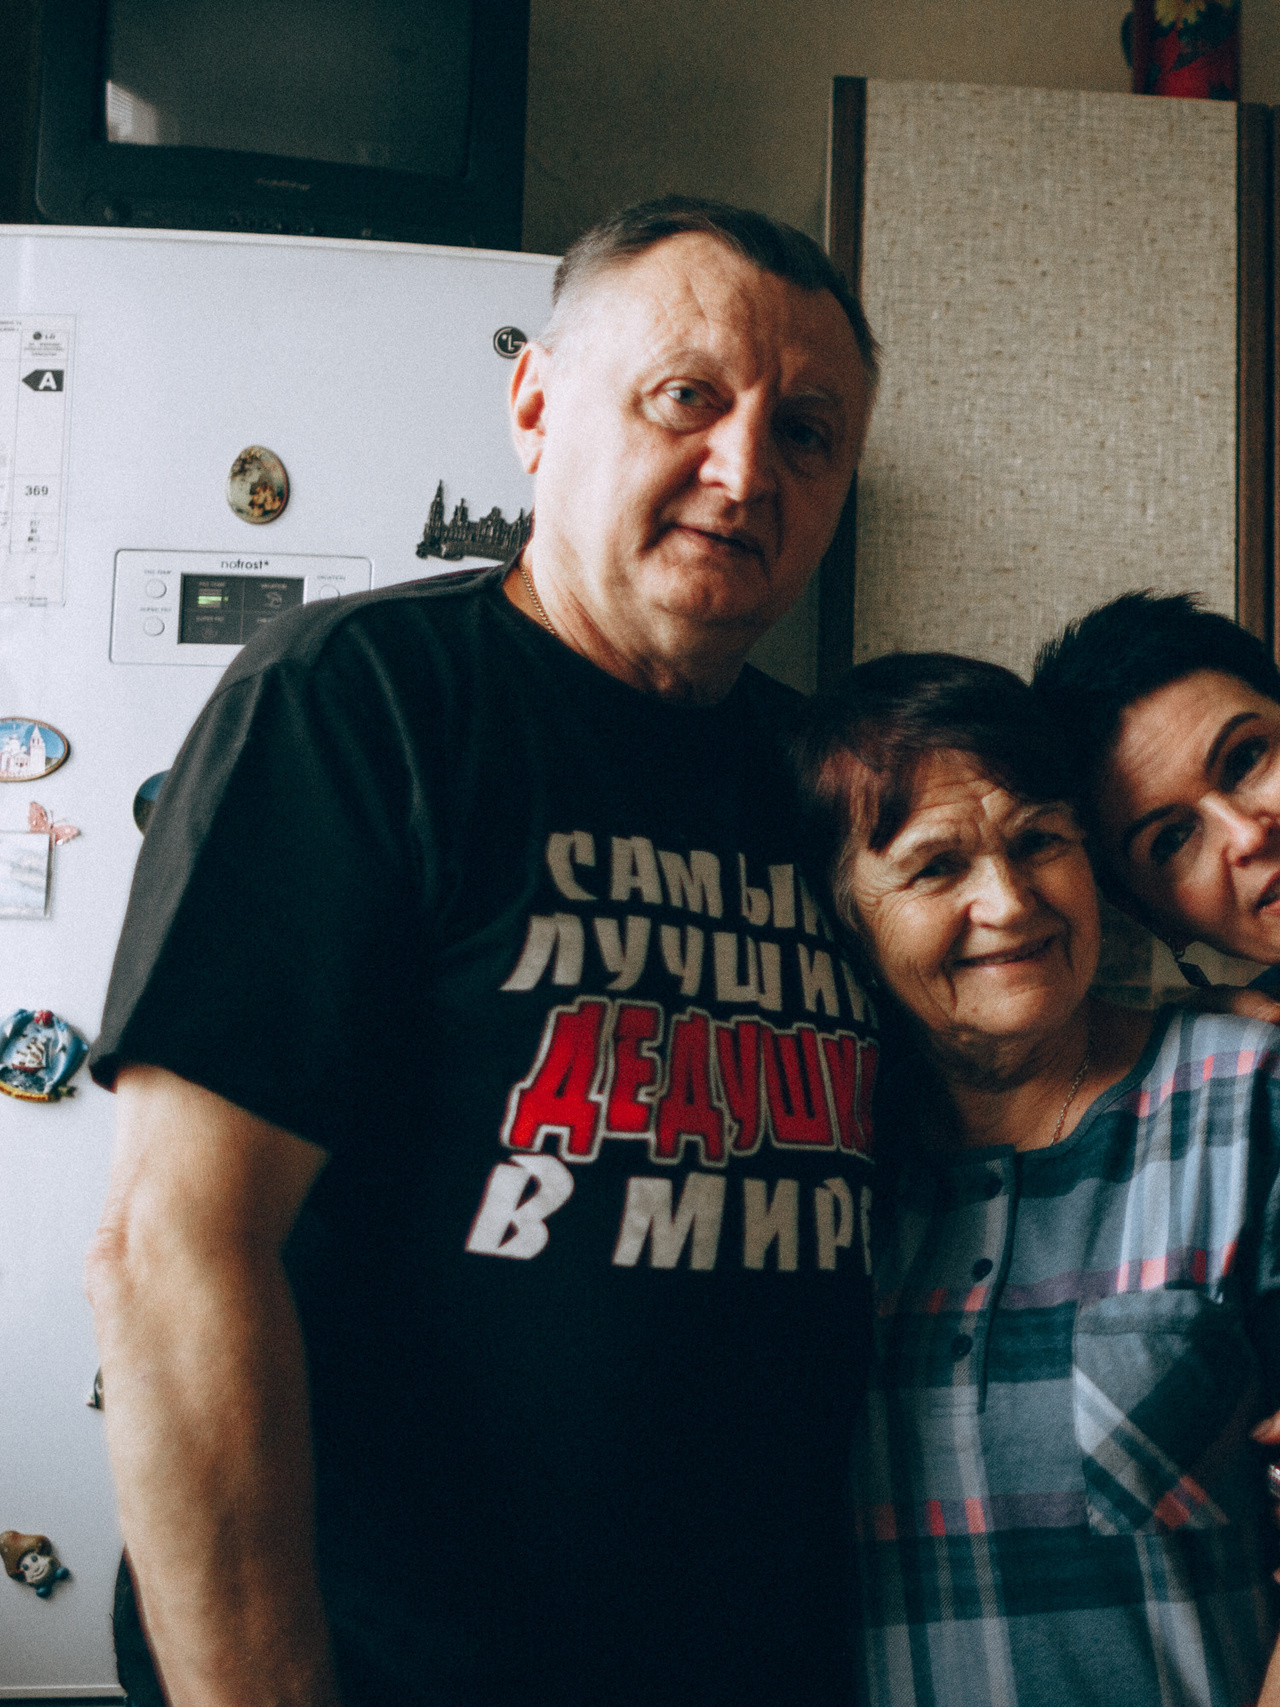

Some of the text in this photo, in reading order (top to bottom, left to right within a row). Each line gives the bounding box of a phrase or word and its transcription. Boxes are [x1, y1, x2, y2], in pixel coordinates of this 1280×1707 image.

[493, 327, 527, 358] LG
[38, 372, 57, 390] A
[25, 485, 49, 496] 369
[465, 1154, 873, 1276] В МИР
